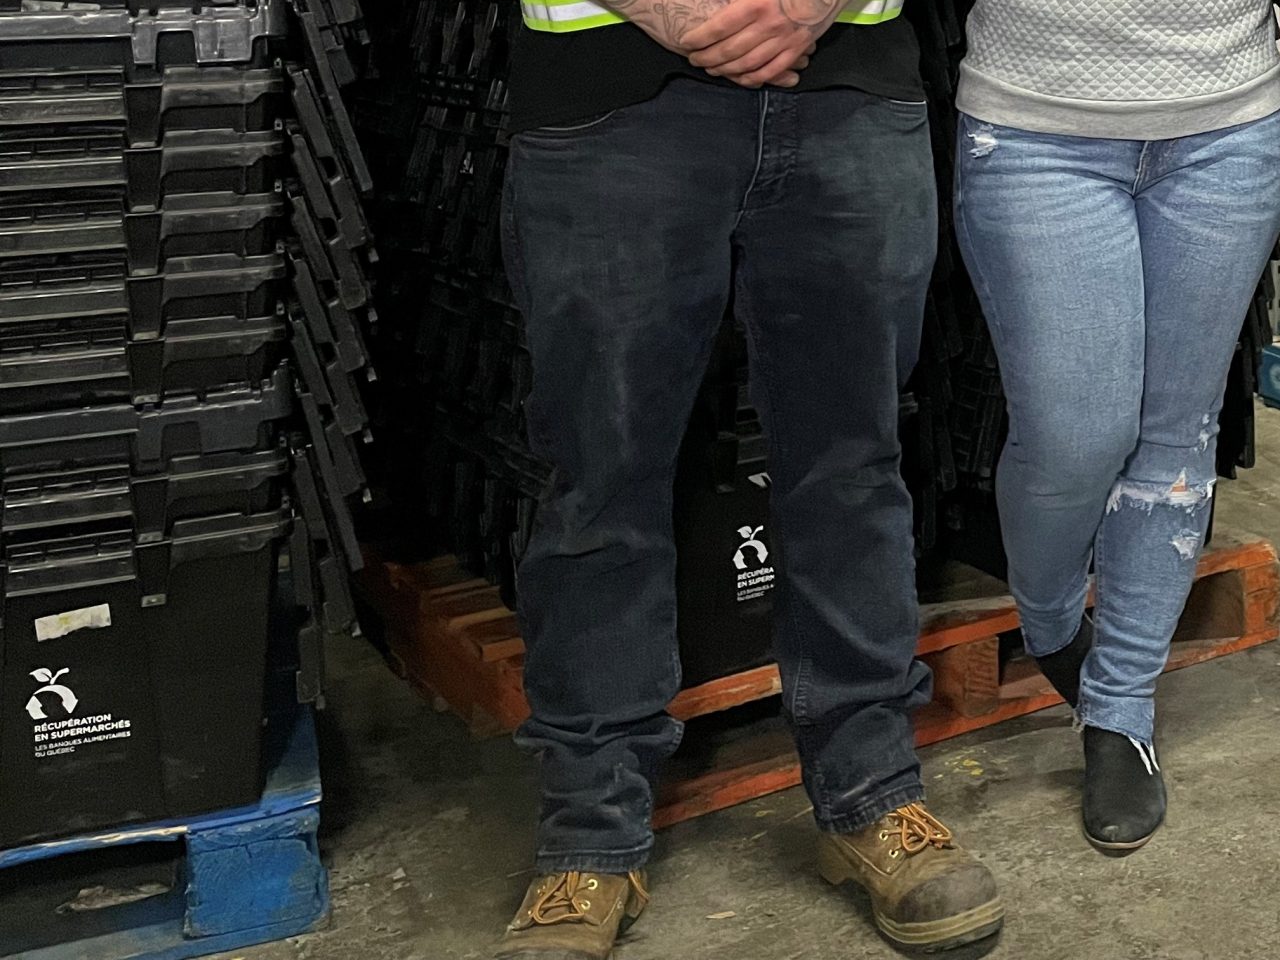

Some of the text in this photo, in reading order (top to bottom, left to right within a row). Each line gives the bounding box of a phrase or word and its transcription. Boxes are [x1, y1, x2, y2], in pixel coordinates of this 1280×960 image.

[34, 713, 112, 733] RÉCUPÉRATION
[34, 719, 131, 743] EN SUPERMARCHÉS
[34, 730, 131, 752] LES BANQUES ALIMENTAIRES
[34, 750, 46, 758] DU
